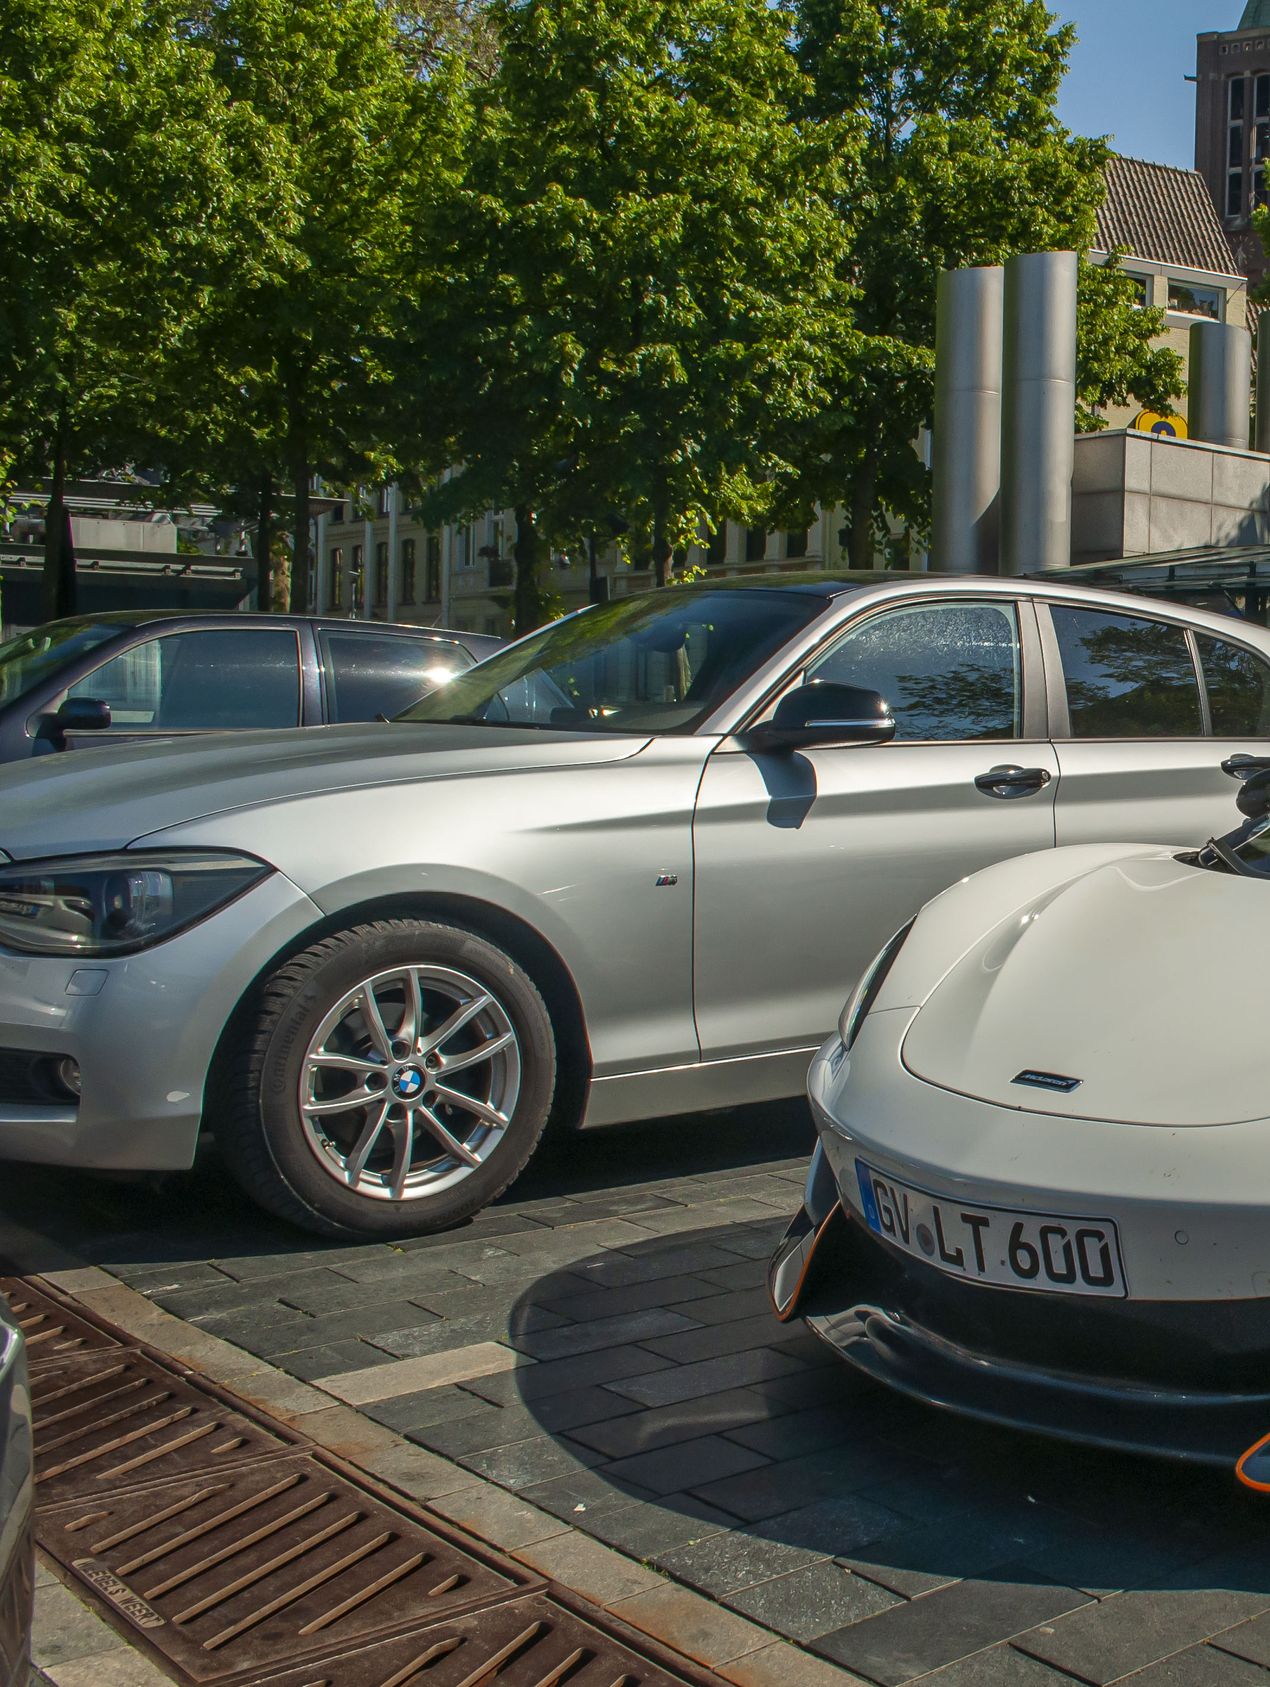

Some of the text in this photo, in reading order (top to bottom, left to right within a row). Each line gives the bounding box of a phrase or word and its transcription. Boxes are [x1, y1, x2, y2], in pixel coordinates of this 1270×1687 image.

[872, 1178, 1115, 1287] GV LT 600
[118, 1595, 163, 1625] WEERT
